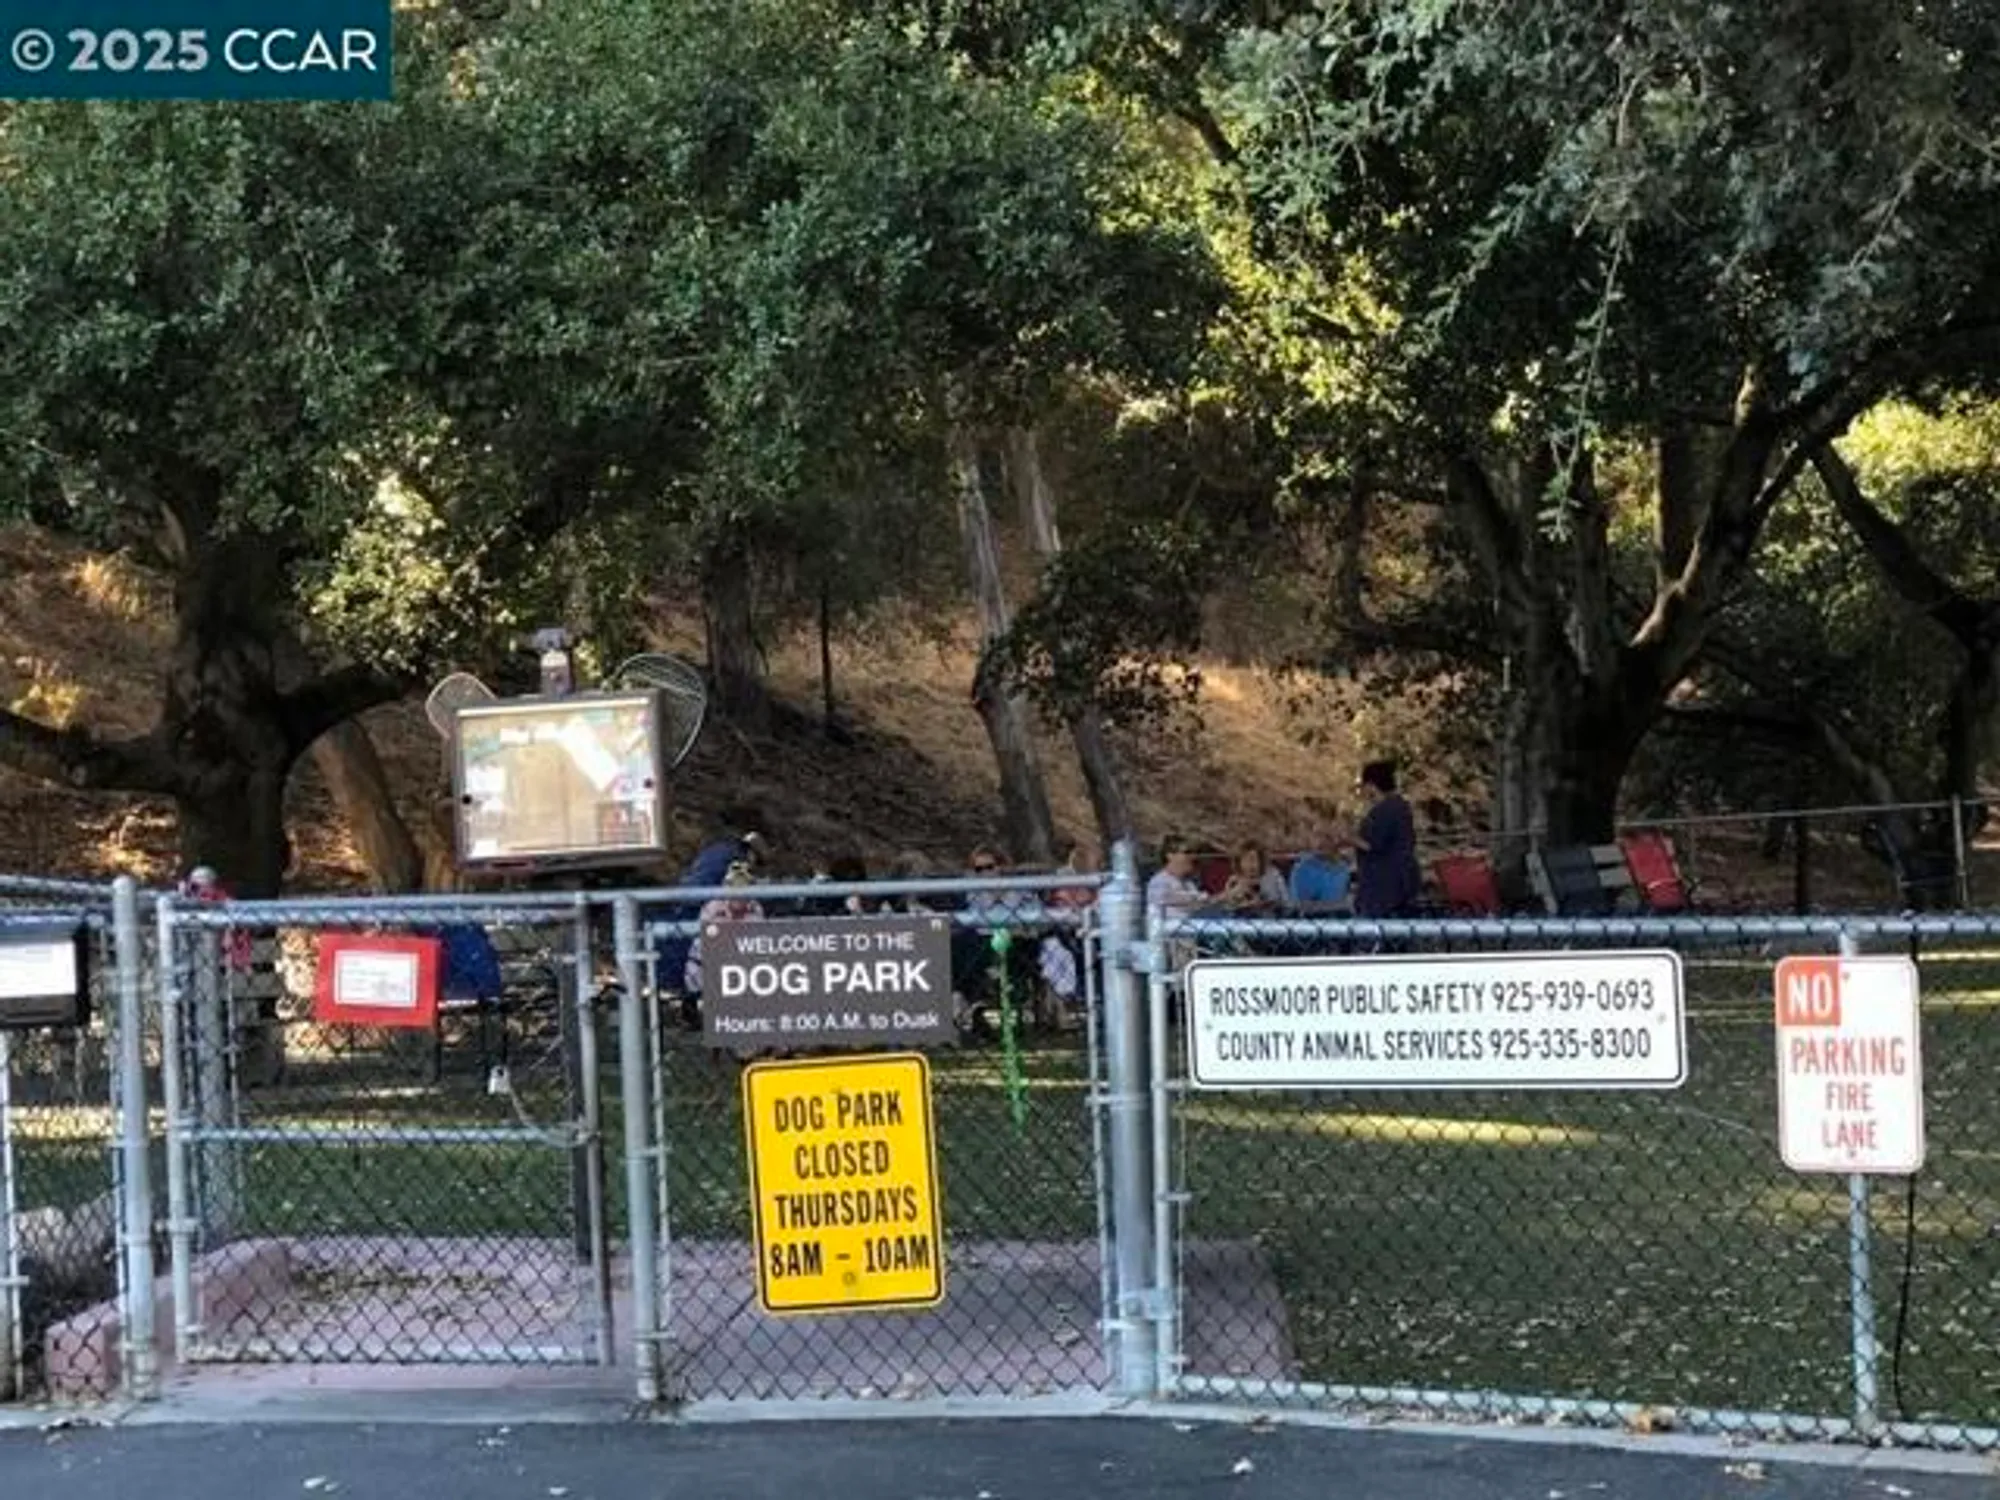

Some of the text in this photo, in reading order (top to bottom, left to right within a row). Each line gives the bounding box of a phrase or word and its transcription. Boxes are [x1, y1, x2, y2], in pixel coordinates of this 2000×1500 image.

[737, 931, 915, 955] WELCOME TO THE
[721, 959, 932, 997] DOG PARK
[1210, 978, 1655, 1016] ROSSMOOR PUBLIC SAFETY 925-939-0693
[1788, 971, 1834, 1018] NO
[715, 1010, 940, 1033] Hours: 8:00 A.M. to Dusk
[1217, 1027, 1652, 1061] COUNTY ANIMAL SERVICES 925-335-8300
[1790, 1035, 1906, 1076] PARKING
[774, 1090, 903, 1132] DOG PARK
[1825, 1081, 1875, 1112] FIRE
[1822, 1119, 1878, 1149] LANE
[795, 1140, 890, 1179] CLOSED
[774, 1185, 918, 1229] THURSDAYS
[770, 1240, 824, 1279] 8AM
[864, 1234, 931, 1274] 10AM
